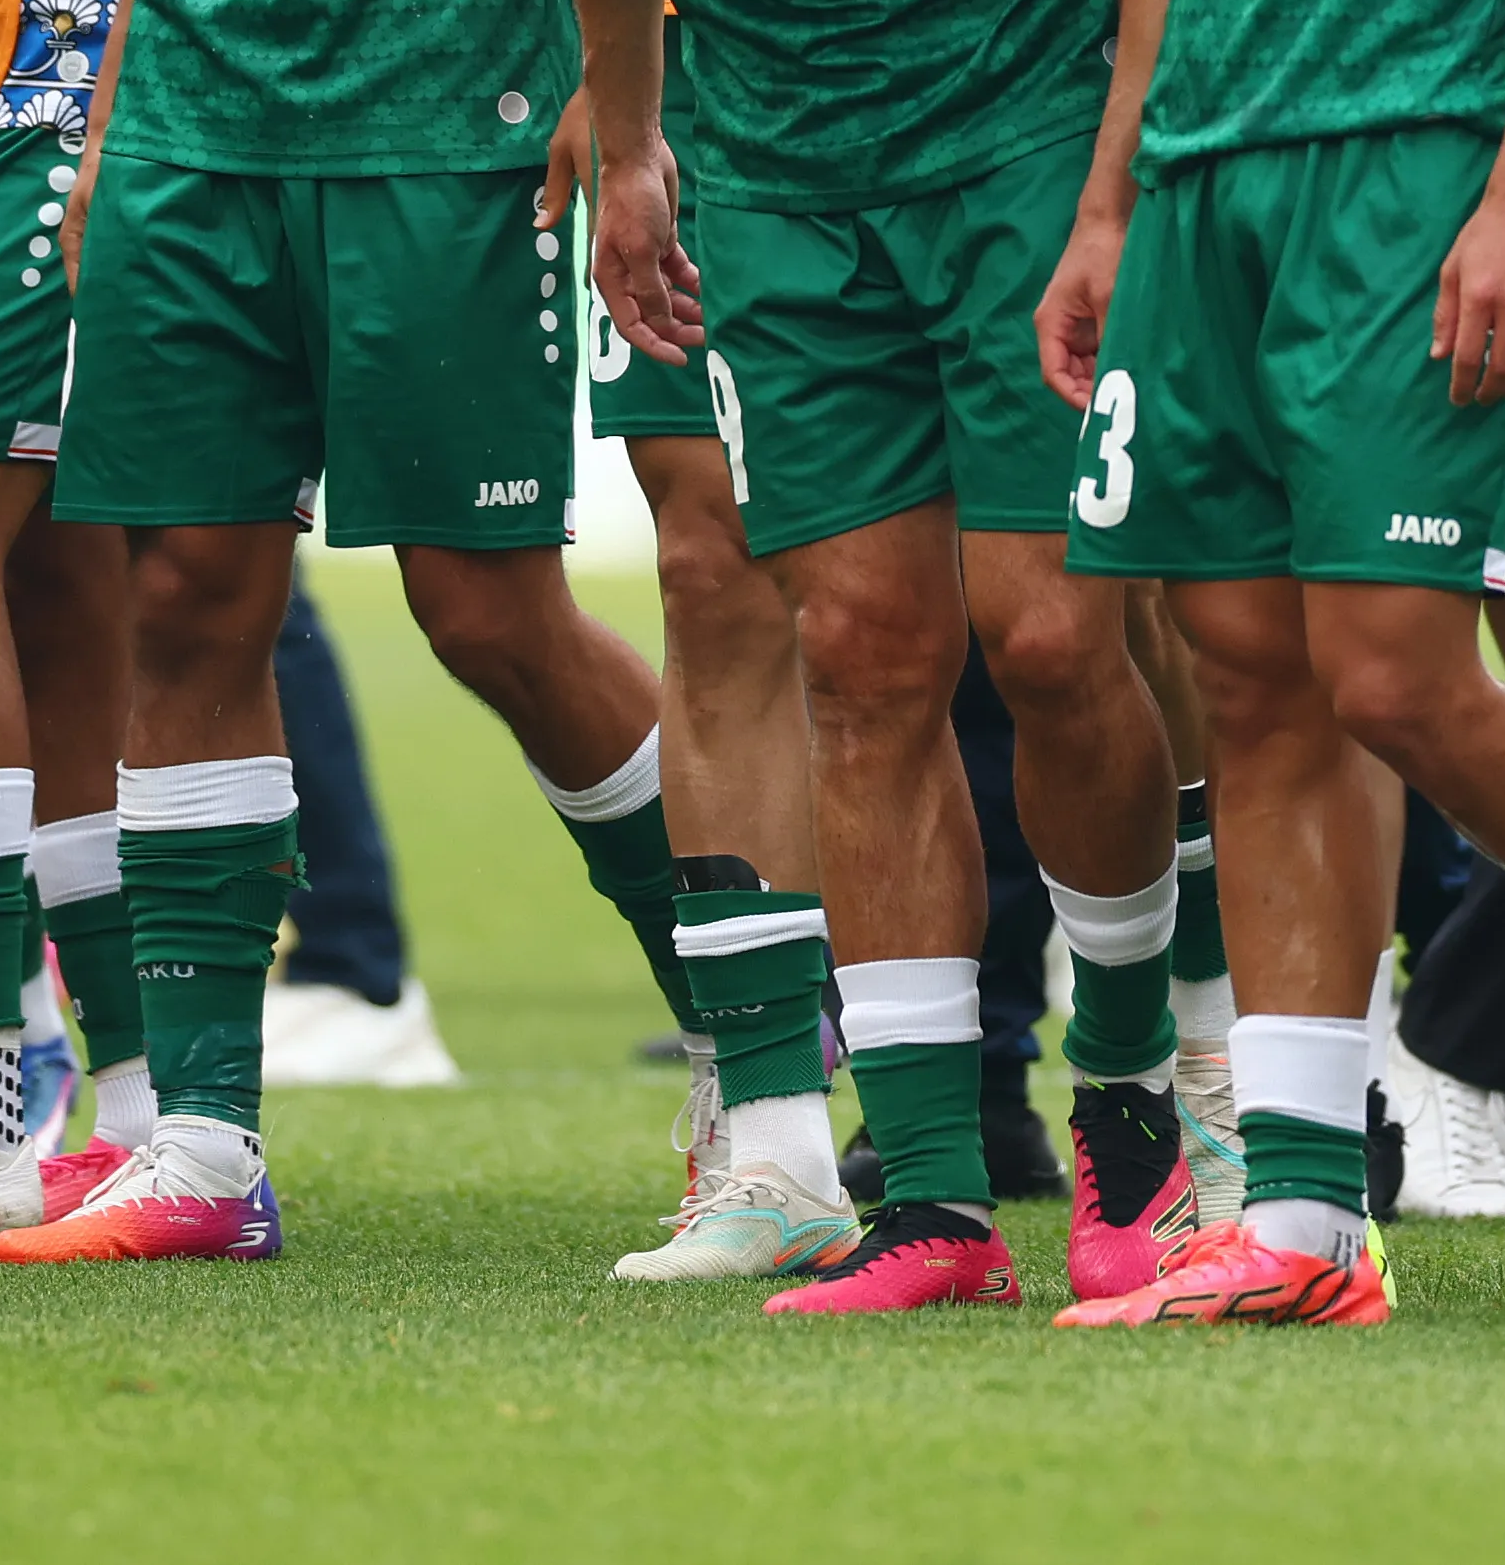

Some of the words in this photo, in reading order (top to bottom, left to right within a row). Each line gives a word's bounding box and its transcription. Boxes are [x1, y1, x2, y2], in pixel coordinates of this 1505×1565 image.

[706, 349, 750, 506] 9
[1068, 368, 1138, 529] 3
[474, 477, 540, 508] JAKO
[1384, 512, 1462, 547] JAKO
